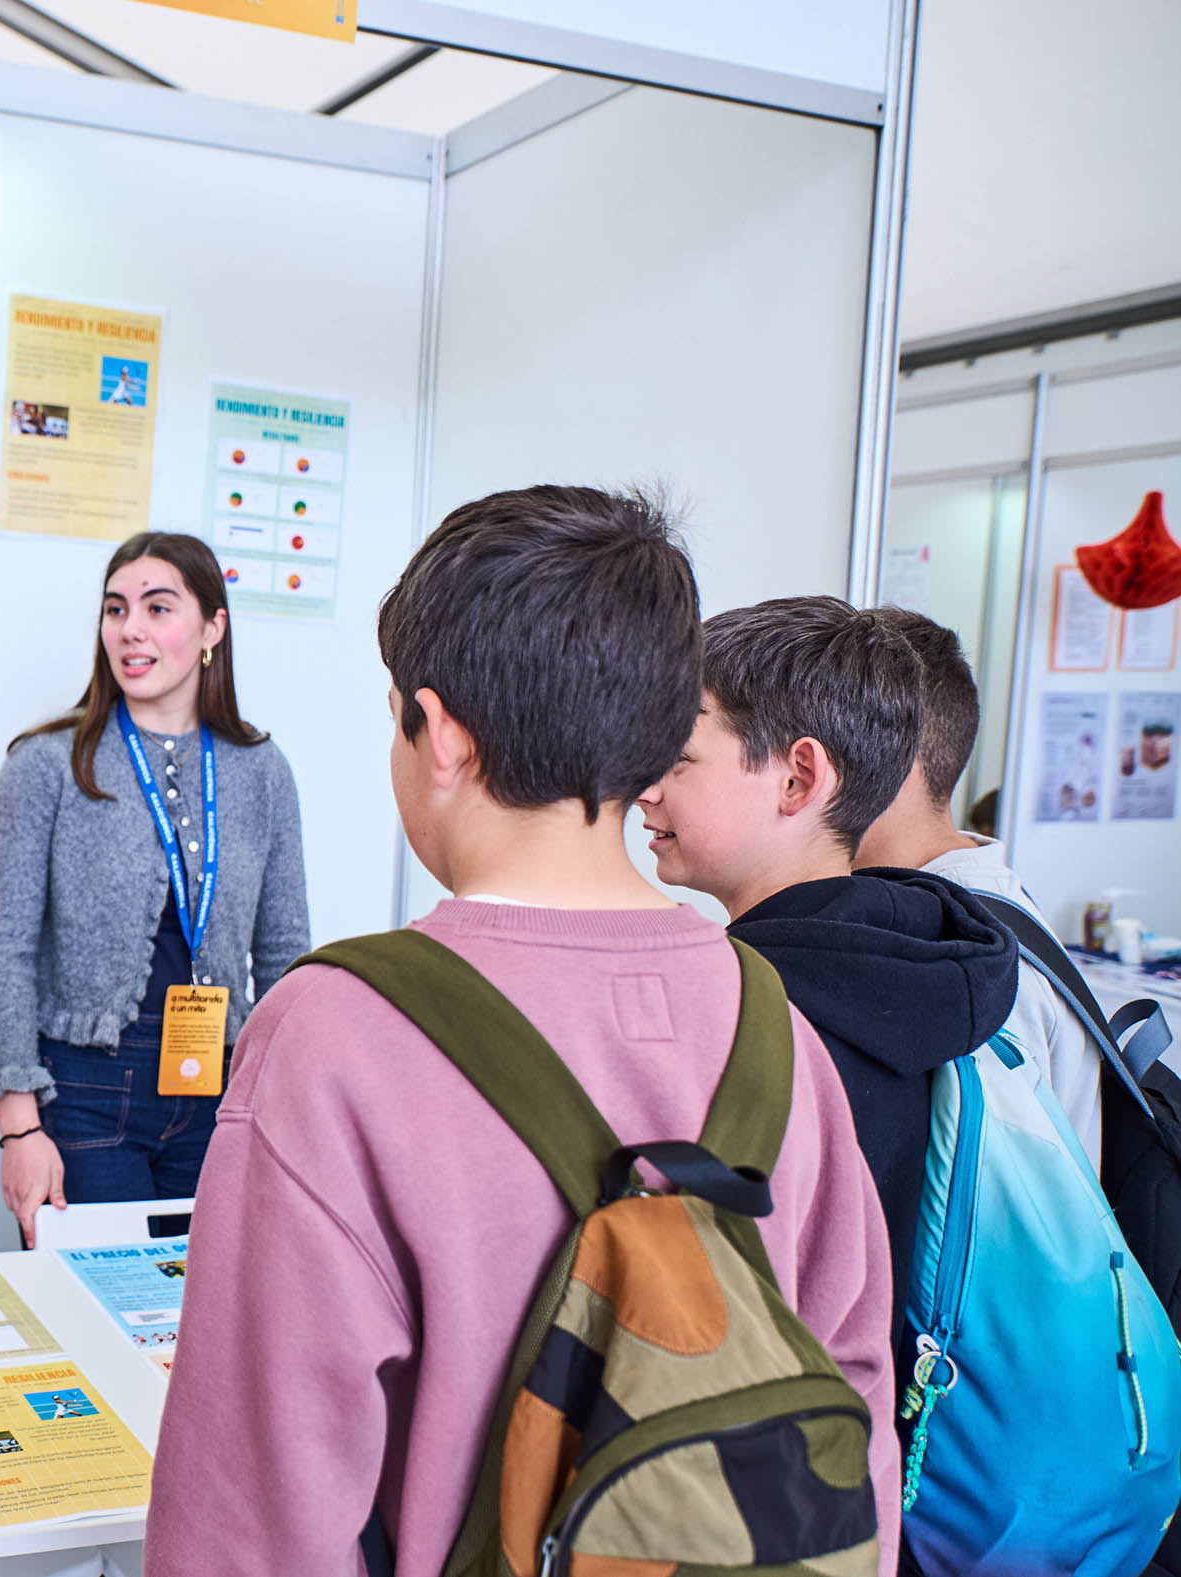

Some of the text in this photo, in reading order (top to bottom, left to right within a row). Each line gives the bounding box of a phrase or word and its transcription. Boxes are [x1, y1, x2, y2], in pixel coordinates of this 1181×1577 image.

[215, 397, 279, 419] RENDIMIENTO
[291, 408, 345, 428] RESILIENCIA
[90, 1249, 142, 1259] PRECIO
[143, 1247, 170, 1256] DEL
[3, 1368, 78, 1384] RESILIENCIA
